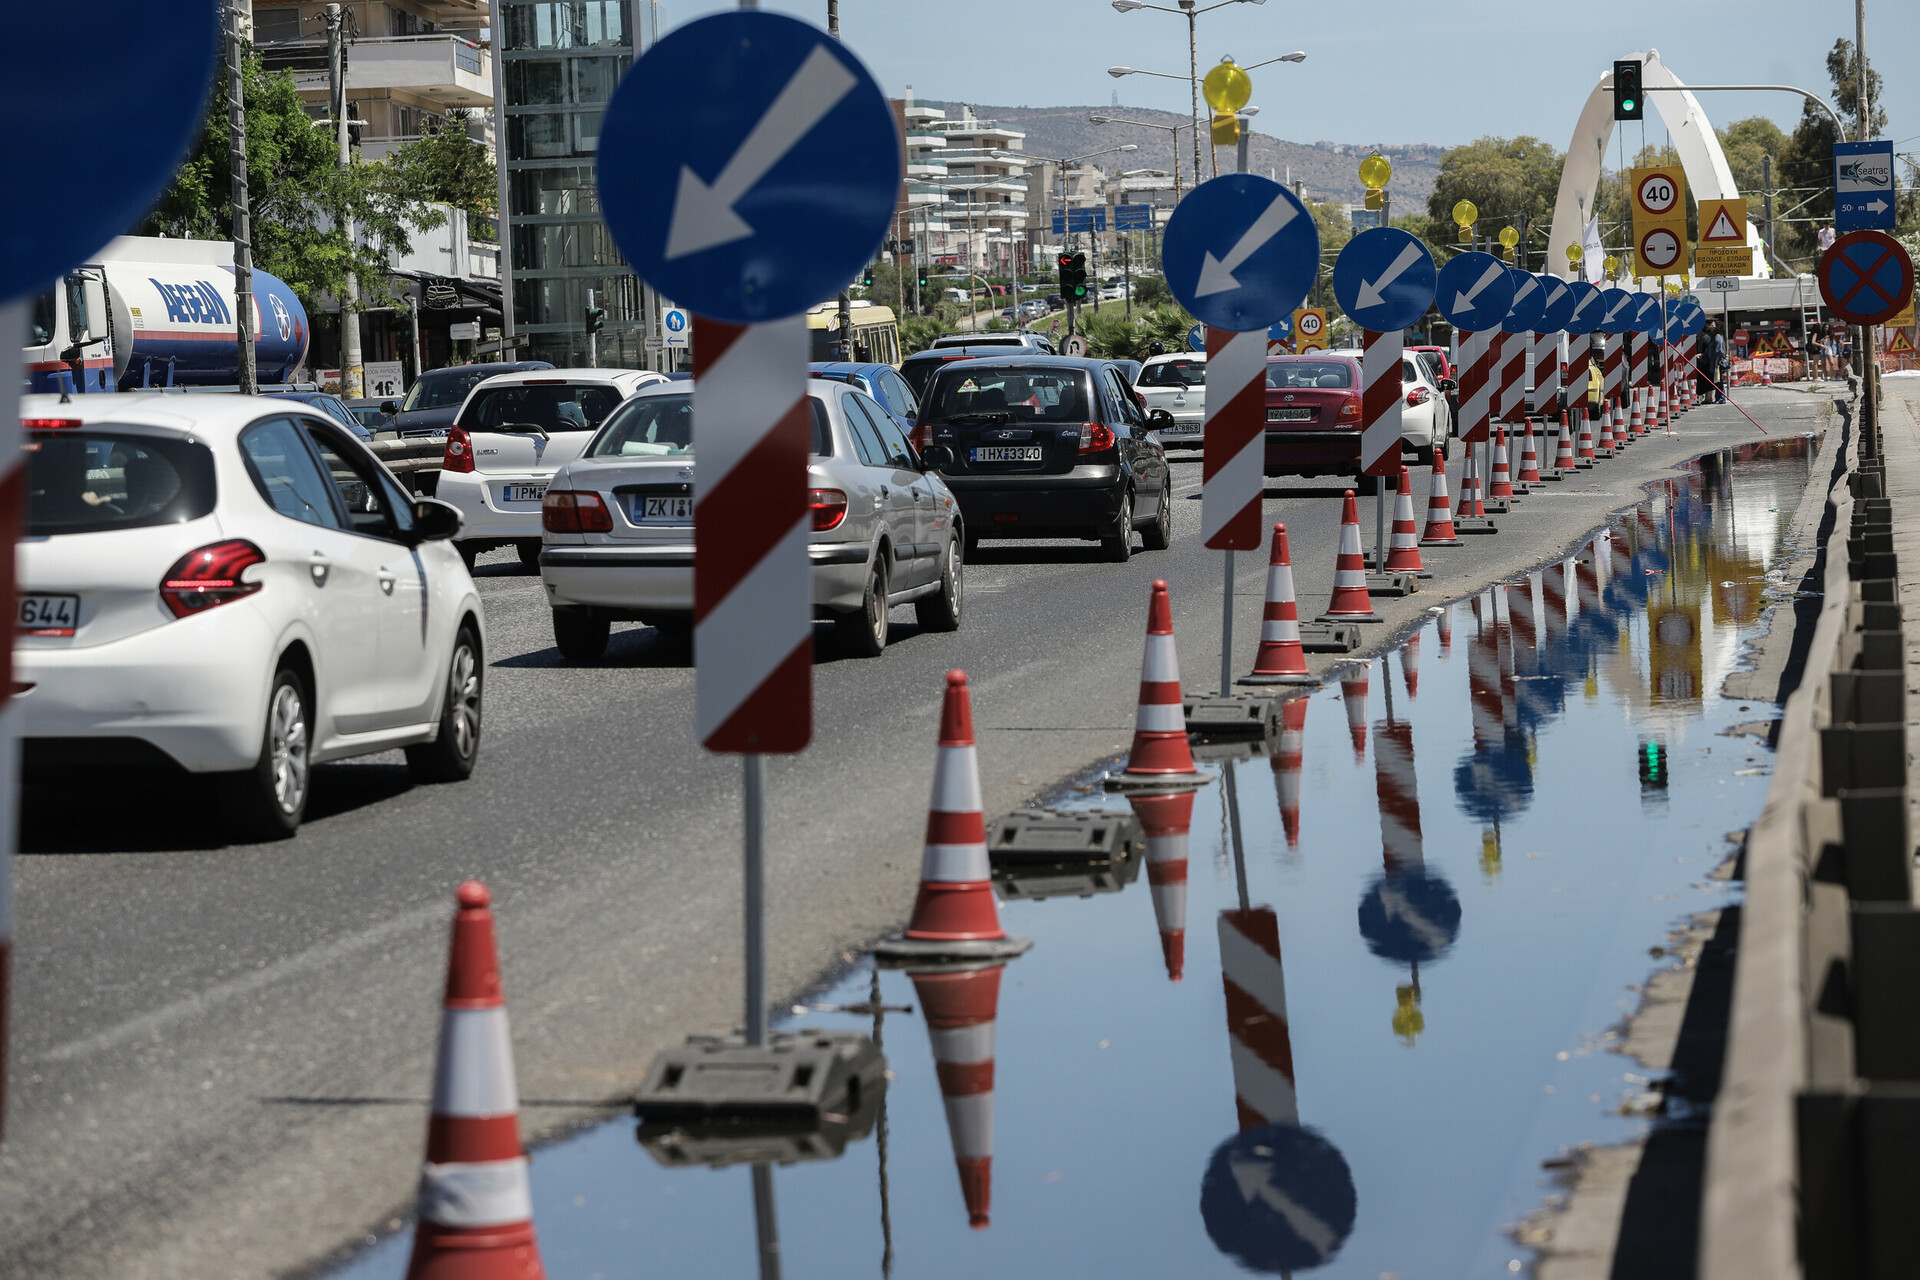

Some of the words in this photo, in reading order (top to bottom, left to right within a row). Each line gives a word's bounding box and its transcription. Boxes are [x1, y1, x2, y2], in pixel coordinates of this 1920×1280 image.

[1858, 166, 1888, 176] seatrac
[1646, 185, 1670, 202] 40
[1842, 204, 1852, 212] 50
[1716, 280, 1728, 289] 50
[148, 277, 232, 325] AEGEAN
[1303, 319, 1318, 329] 40
[374, 381, 395, 396] 1€
[1009, 448, 1041, 460] 3340
[515, 487, 536, 500] IPM
[647, 499, 675, 516] ZKI
[15, 599, 70, 624] 644
